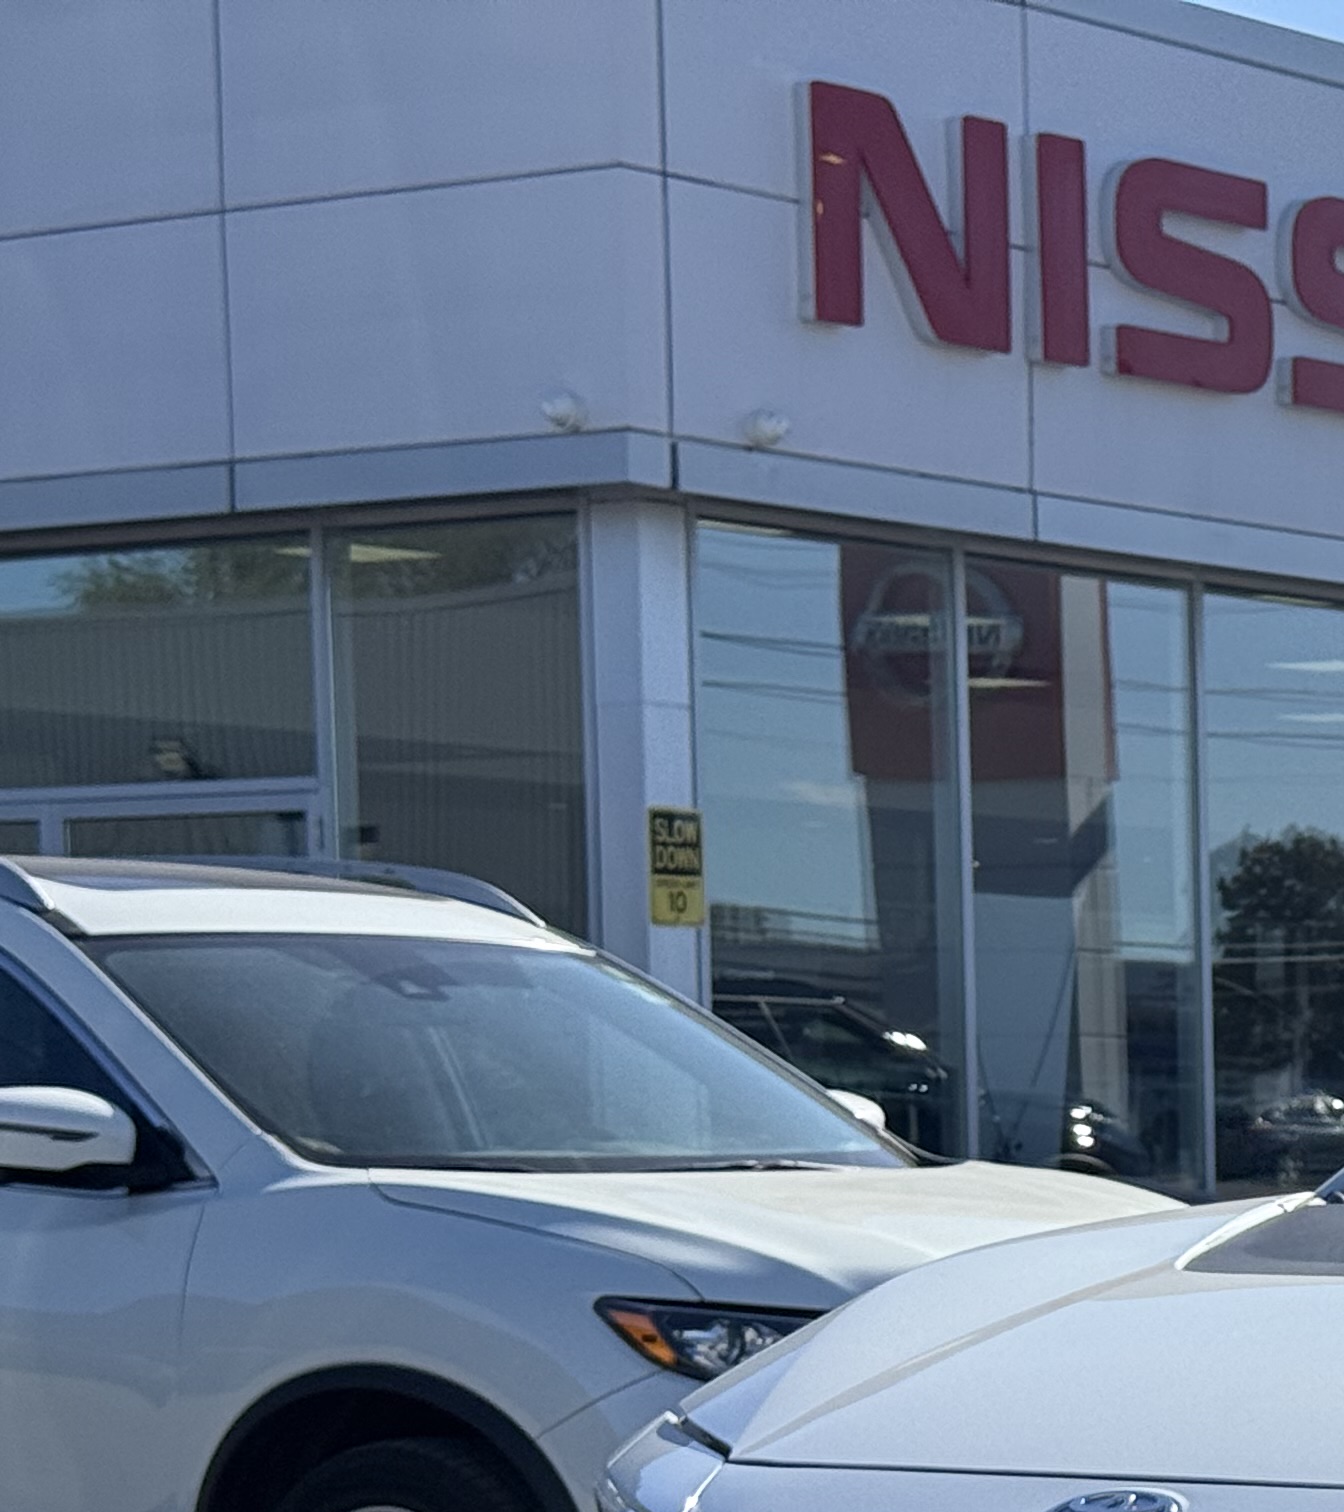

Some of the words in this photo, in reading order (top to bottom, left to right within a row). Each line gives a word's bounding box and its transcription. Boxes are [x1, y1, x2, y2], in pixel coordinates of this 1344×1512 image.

[654, 817, 698, 843] SLOW
[655, 846, 699, 869] DOWN
[668, 889, 688, 913] 10
